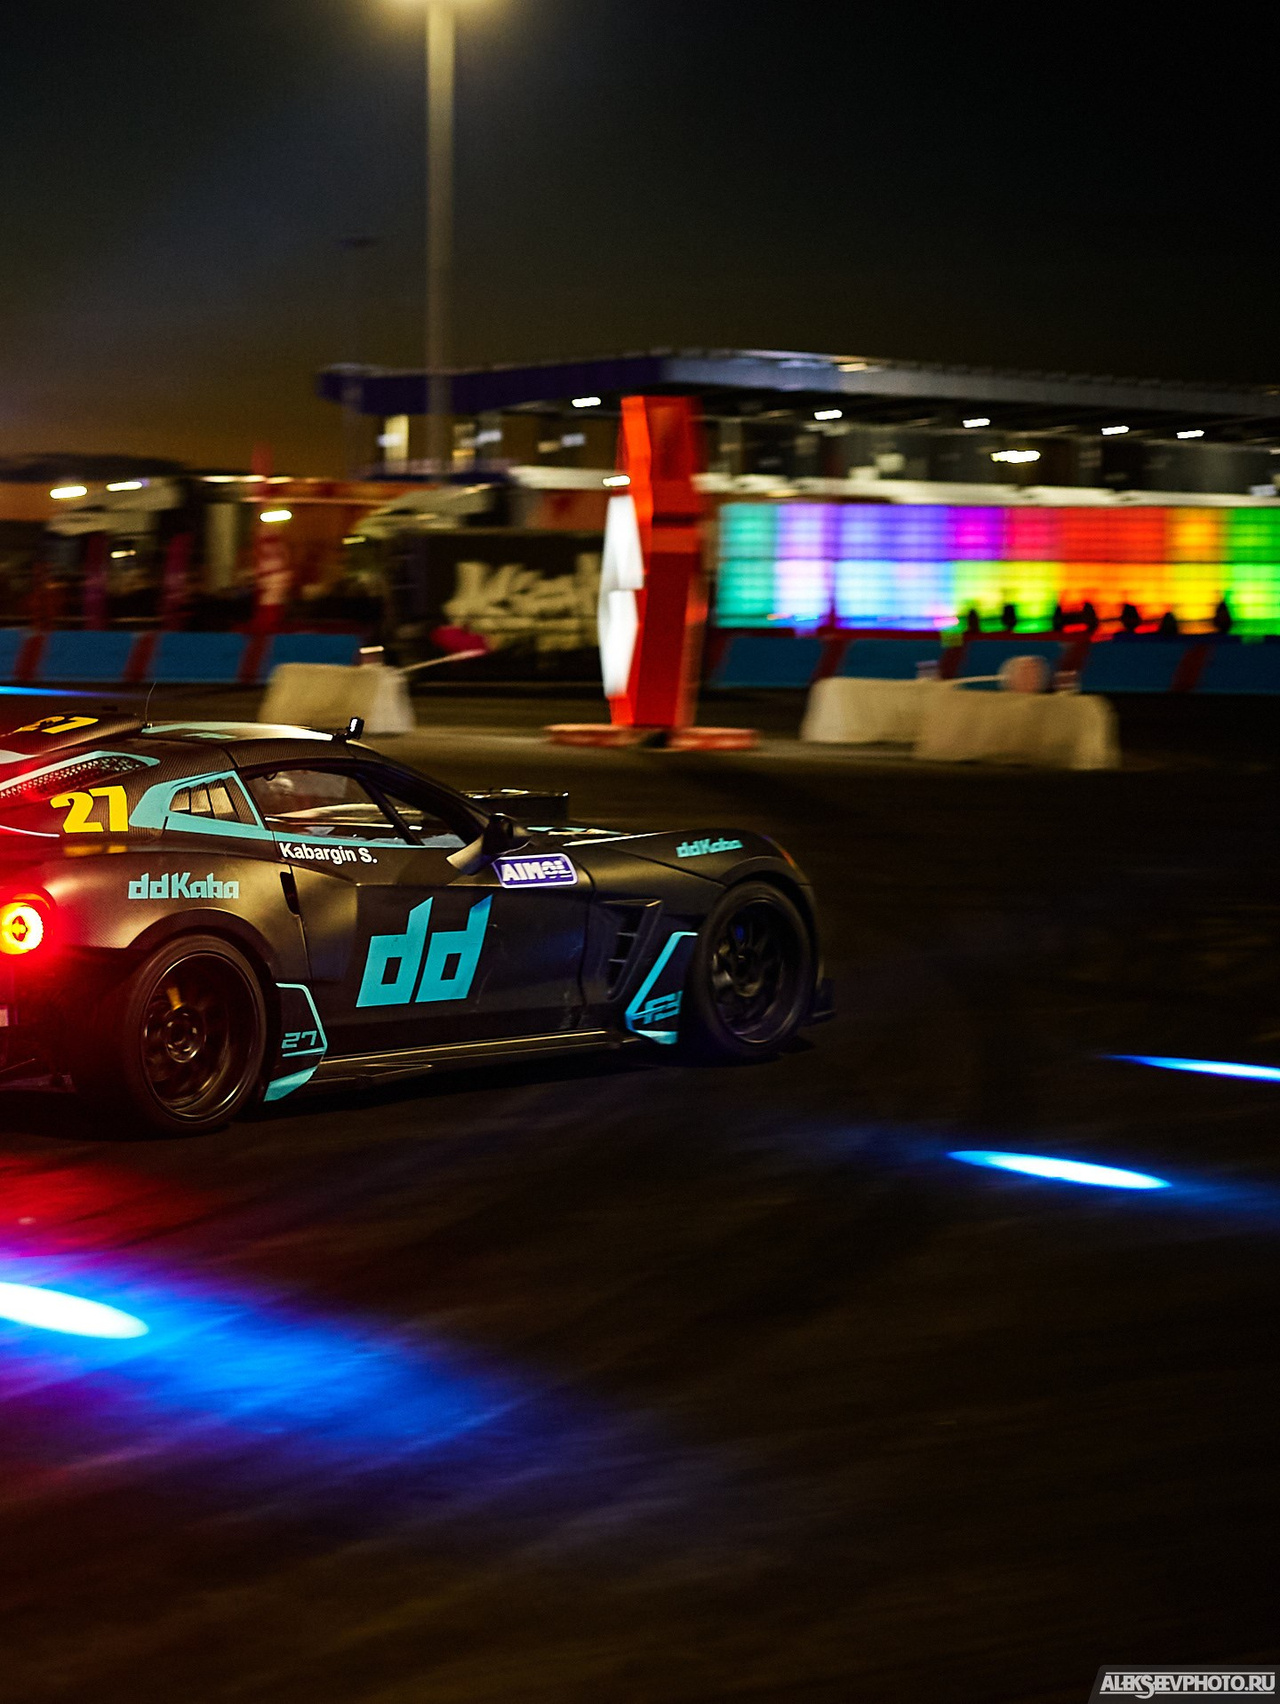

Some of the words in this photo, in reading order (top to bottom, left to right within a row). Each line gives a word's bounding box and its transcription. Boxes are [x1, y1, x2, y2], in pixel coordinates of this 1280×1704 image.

[49, 785, 129, 834] 27
[279, 842, 358, 865] Kabargin
[358, 847, 378, 864] S.
[676, 838, 744, 859] ddKaba
[128, 872, 240, 899] ddKaba
[355, 893, 494, 1009] dd
[281, 1030, 318, 1049] 27
